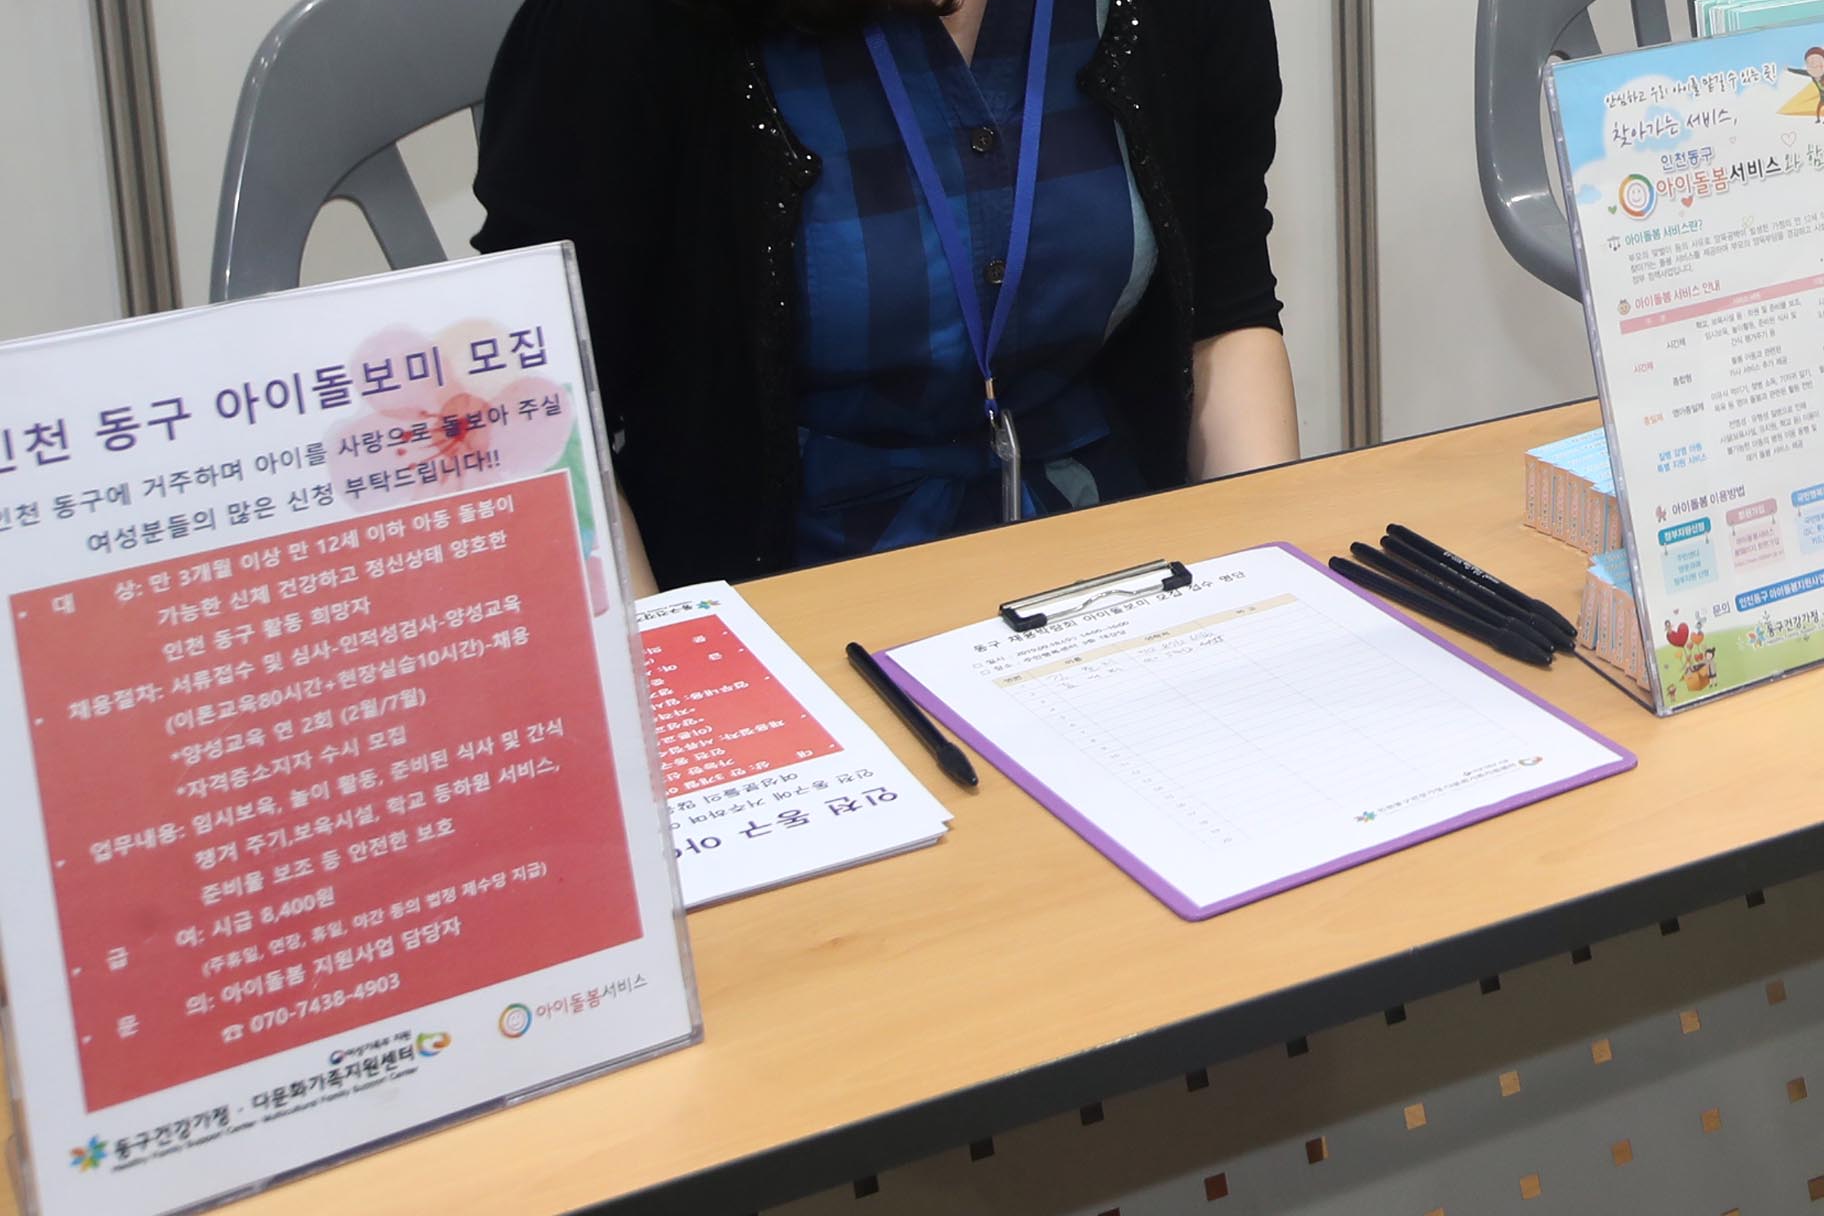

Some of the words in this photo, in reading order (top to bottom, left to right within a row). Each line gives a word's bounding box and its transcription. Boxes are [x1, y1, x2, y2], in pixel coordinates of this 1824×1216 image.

[1659, 145, 1713, 171] 인천동구
[95, 396, 191, 452] 동구
[214, 345, 444, 425] 아이돌보미
[467, 325, 547, 375] 모집
[52, 482, 131, 520] 동구에
[142, 458, 244, 498] 거주하며
[253, 441, 327, 475] 아이를
[337, 421, 432, 457] 사랑으로
[440, 403, 509, 439] 돌보아
[517, 393, 562, 421] 주실
[86, 507, 216, 553] 여성분들의
[226, 496, 276, 526] 많은
[287, 482, 334, 513] 신청
[344, 449, 500, 500] 부탁드립니다!!
[147, 570, 172, 594] 만
[178, 558, 232, 587] 3개월
[239, 546, 282, 571] 이상
[287, 540, 309, 562] 만
[315, 528, 360, 554] 12세
[364, 518, 407, 543] 이하
[411, 508, 451, 532] 아동
[458, 493, 515, 524] 돌봄이
[157, 595, 222, 625] 가능한
[228, 583, 271, 611] 신체
[277, 564, 360, 600] 건강하고
[364, 543, 444, 579] 정신상태
[449, 529, 508, 559] 양호한
[161, 634, 206, 662] 인천
[213, 623, 256, 650] 동구
[261, 611, 304, 638] 활동
[310, 594, 372, 625] 희망자
[68, 682, 165, 720] 채용절차:
[170, 659, 255, 694] 서류접수
[261, 651, 283, 673] 및
[271, 718, 294, 742] 연
[300, 708, 333, 734] 2회
[339, 687, 427, 726] (2월/7월)
[318, 736, 360, 765] 수시
[367, 724, 407, 751] 모집
[89, 822, 186, 863] 업무내용:
[190, 795, 283, 835] 임시보육,
[289, 779, 330, 809] 놀이
[337, 767, 384, 795] 활동,
[390, 748, 449, 781] 준비된
[455, 735, 495, 761] 식사
[500, 729, 521, 751] 및
[526, 716, 564, 744] 간식
[194, 840, 238, 870] 챙겨
[386, 790, 427, 815] 학교
[433, 771, 490, 804] 등하원
[497, 756, 560, 784] 서비스,
[739, 808, 811, 839] 동구
[824, 786, 898, 817] 인천
[200, 870, 265, 906] 준비물
[272, 857, 315, 884] 보조
[320, 848, 342, 871] 등
[346, 829, 409, 863] 안전한
[416, 816, 456, 843] 보호
[219, 964, 307, 1004] 아이돌봄
[312, 934, 395, 975] 지원사업
[399, 915, 462, 950] 담당자
[248, 972, 401, 1034] 070-7438-4903
[534, 973, 648, 1019] 아이돌봄서비스
[114, 1106, 229, 1161] 동구건강가정
[251, 1044, 415, 1109] 다문화가족지원센터
